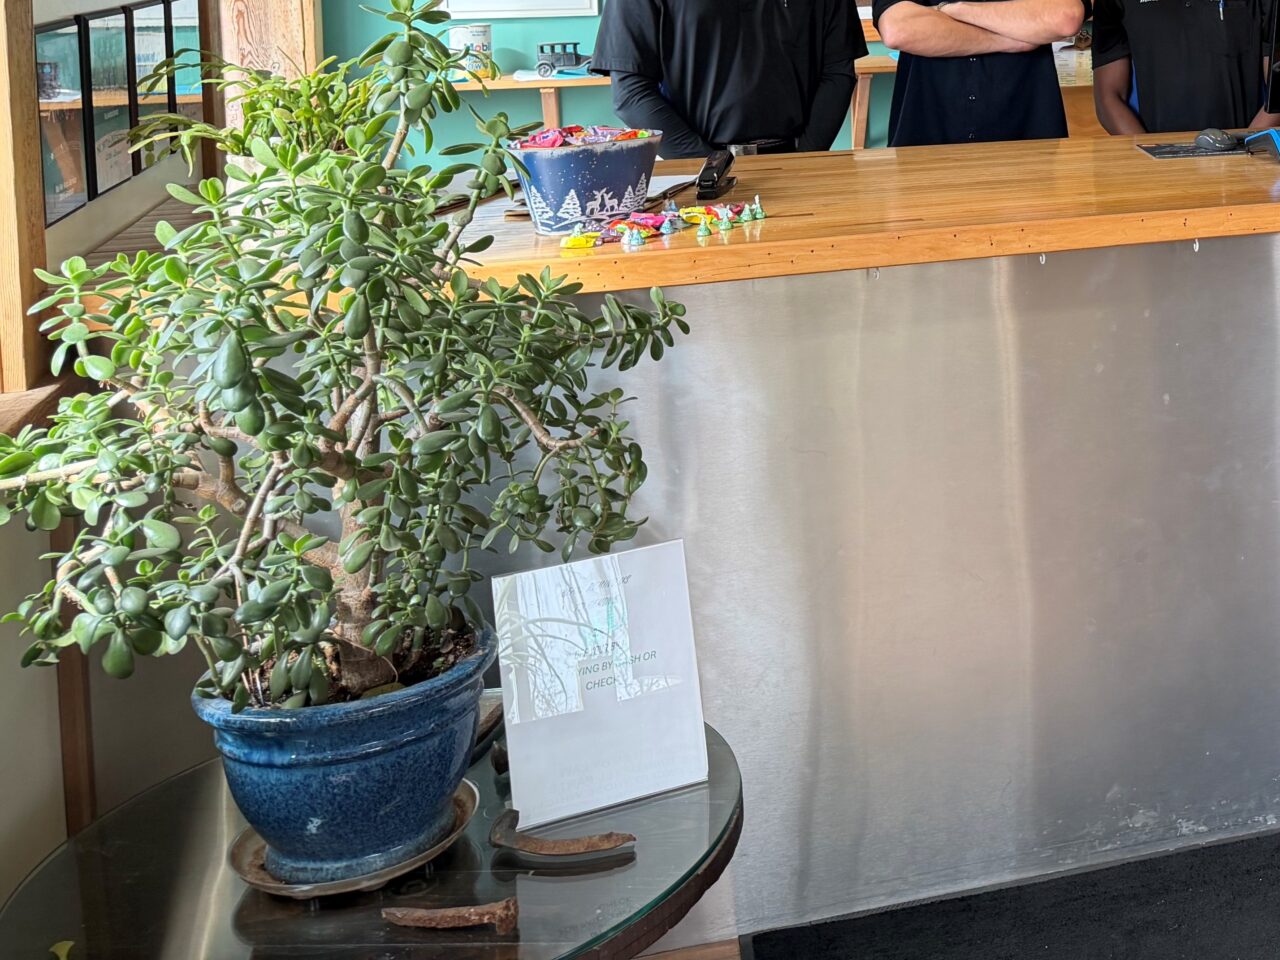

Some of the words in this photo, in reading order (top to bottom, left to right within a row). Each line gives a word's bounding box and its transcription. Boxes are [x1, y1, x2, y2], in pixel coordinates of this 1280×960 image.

[578, 663, 599, 676] YING
[602, 661, 614, 671] BY
[643, 650, 656, 661] OR
